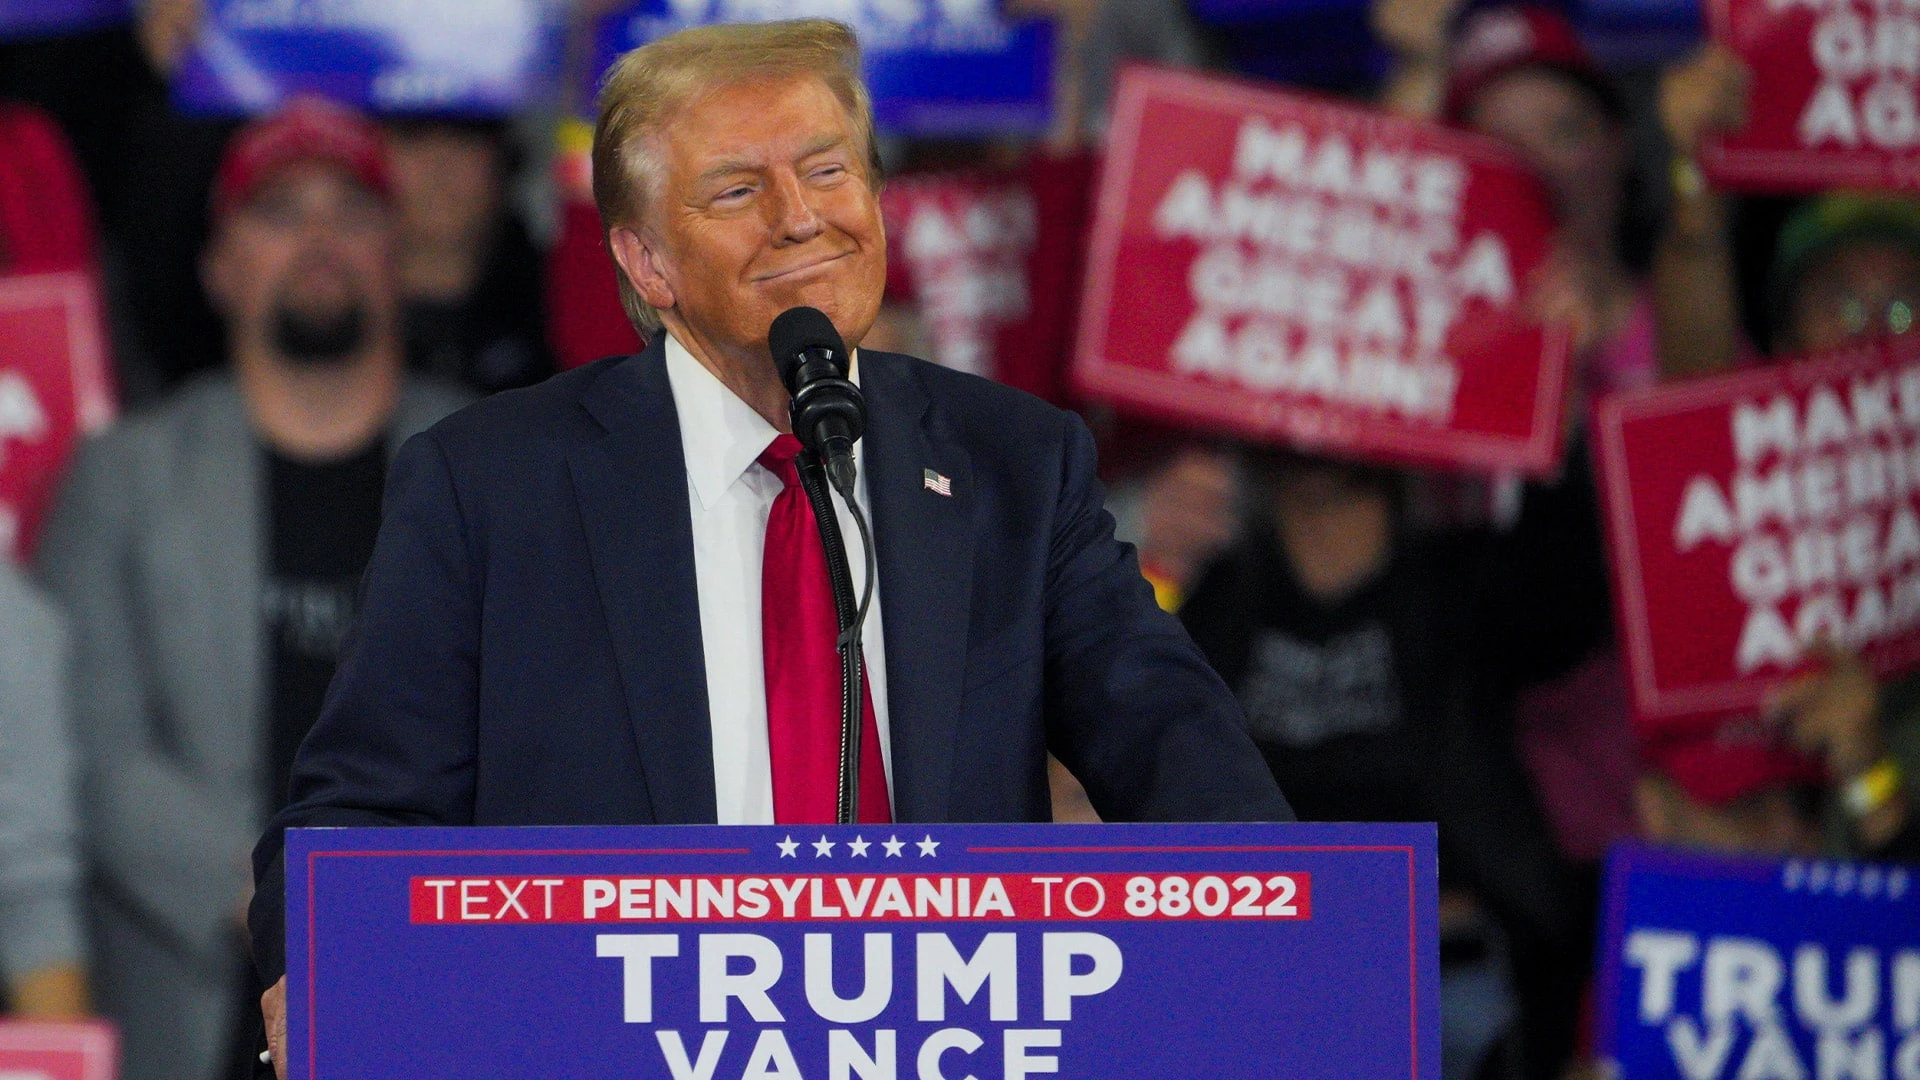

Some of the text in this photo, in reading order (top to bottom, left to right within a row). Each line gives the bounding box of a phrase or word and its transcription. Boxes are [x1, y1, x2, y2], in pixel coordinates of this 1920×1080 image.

[1235, 117, 1469, 216] MAKE
[1155, 168, 1515, 306] AMERICA
[1190, 238, 1463, 352] GREAT
[1672, 443, 1920, 554] AMERI
[425, 876, 1297, 919] TEXT PENNSYLVANIA TO 88022
[596, 932, 1123, 1024] TRUMP
[1624, 927, 1920, 1032] TRU
[655, 1028, 1062, 1080] VANCE
